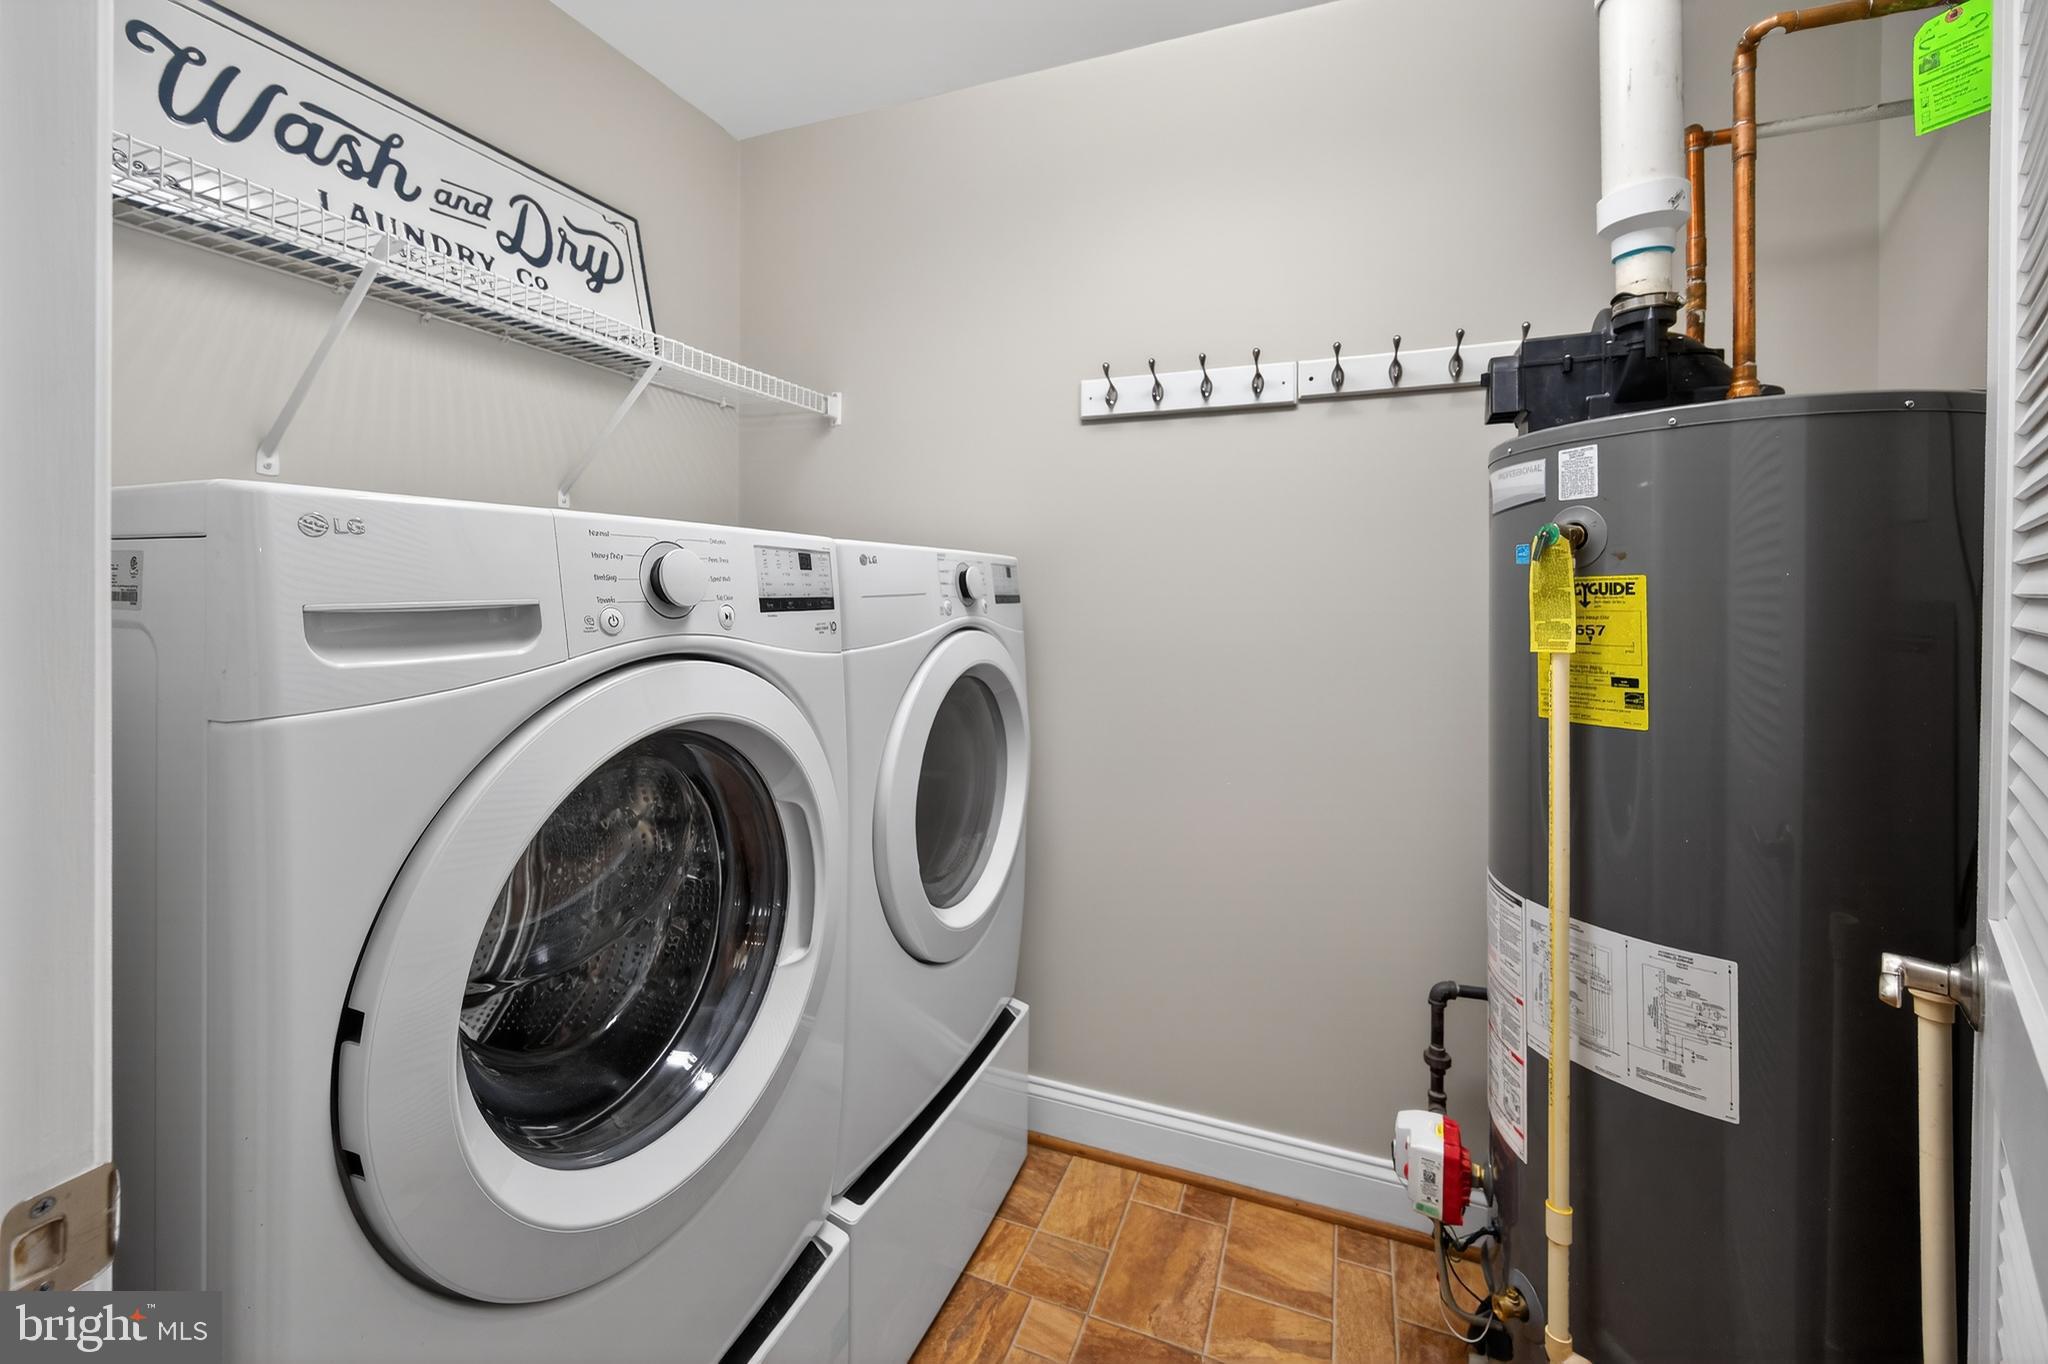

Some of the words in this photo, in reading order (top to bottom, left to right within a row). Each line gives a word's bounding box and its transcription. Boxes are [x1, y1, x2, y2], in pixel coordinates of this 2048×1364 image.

[125, 19, 421, 202] Wash
[434, 186, 493, 221] and
[497, 194, 624, 292] Dry
[1575, 581, 1636, 597] GYGUIDE
